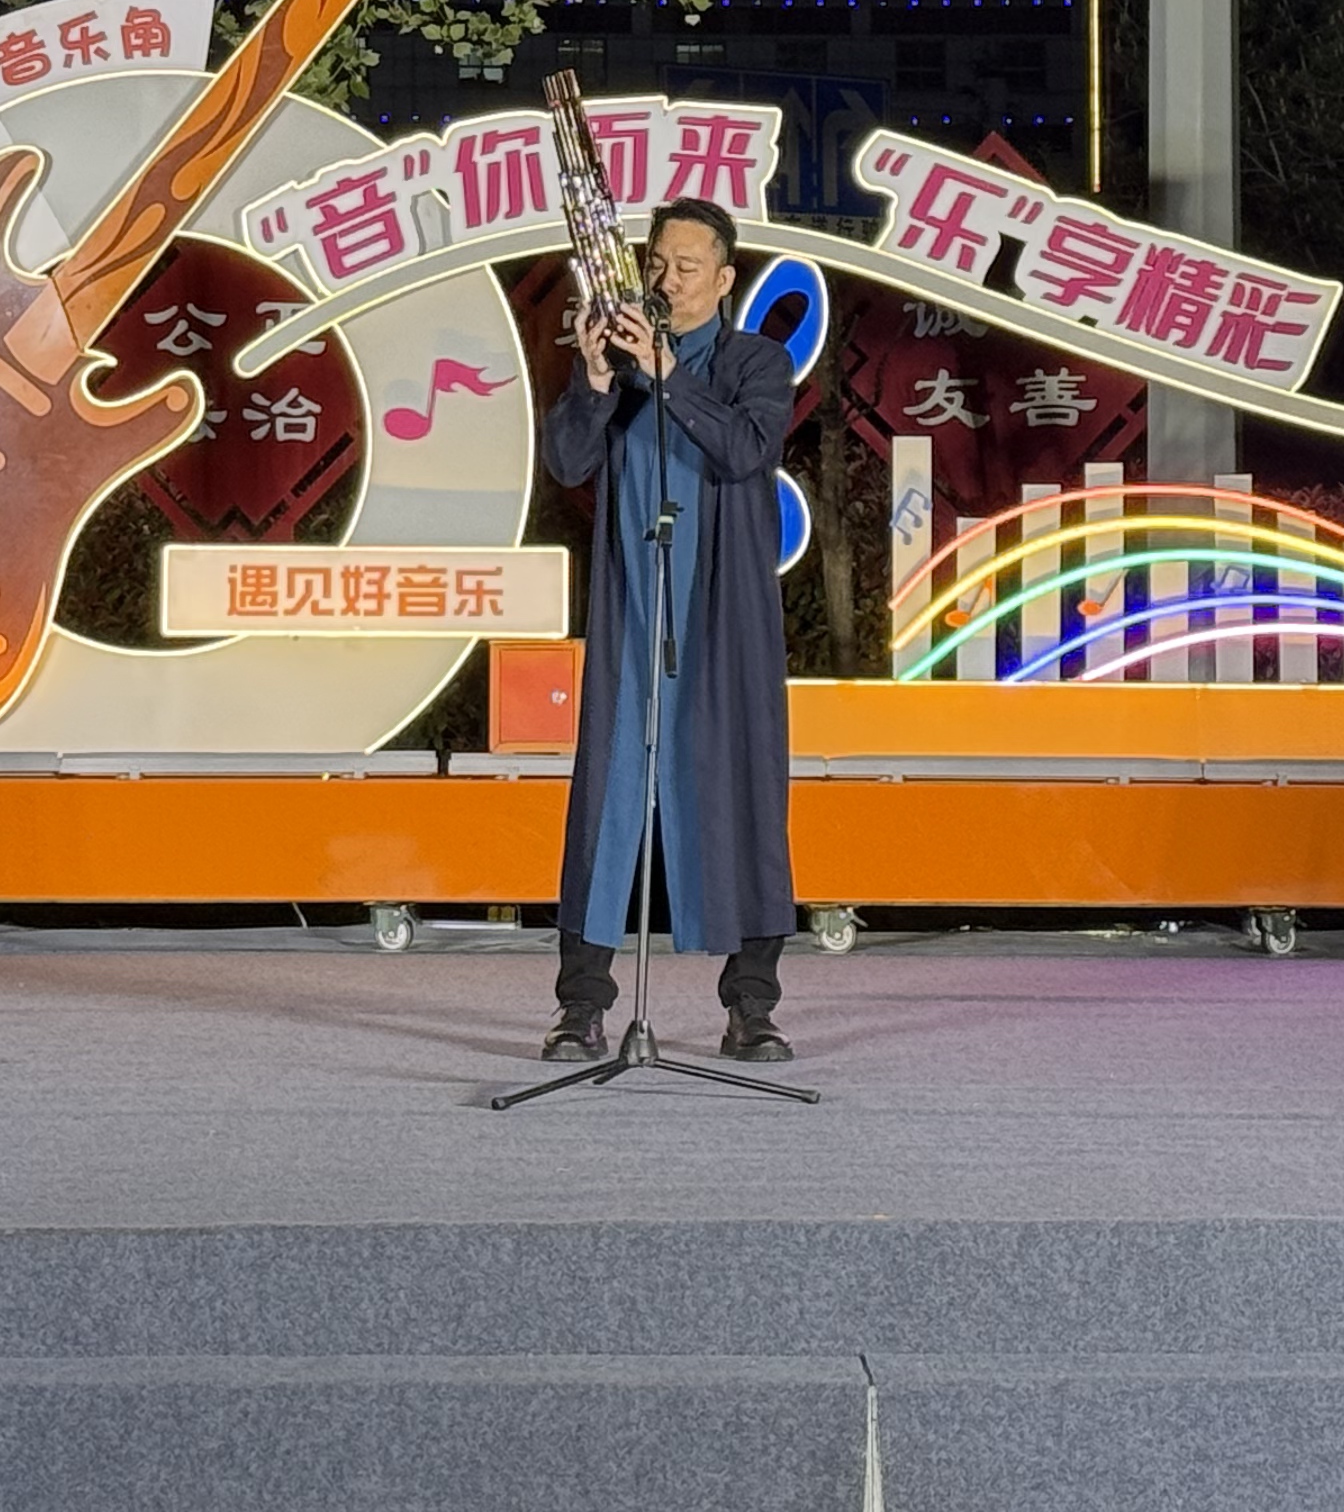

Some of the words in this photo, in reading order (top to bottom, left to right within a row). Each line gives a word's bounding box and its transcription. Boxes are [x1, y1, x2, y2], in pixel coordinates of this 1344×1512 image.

[902, 366, 1098, 430] 友善
[227, 564, 504, 618] 遇见好音乐
